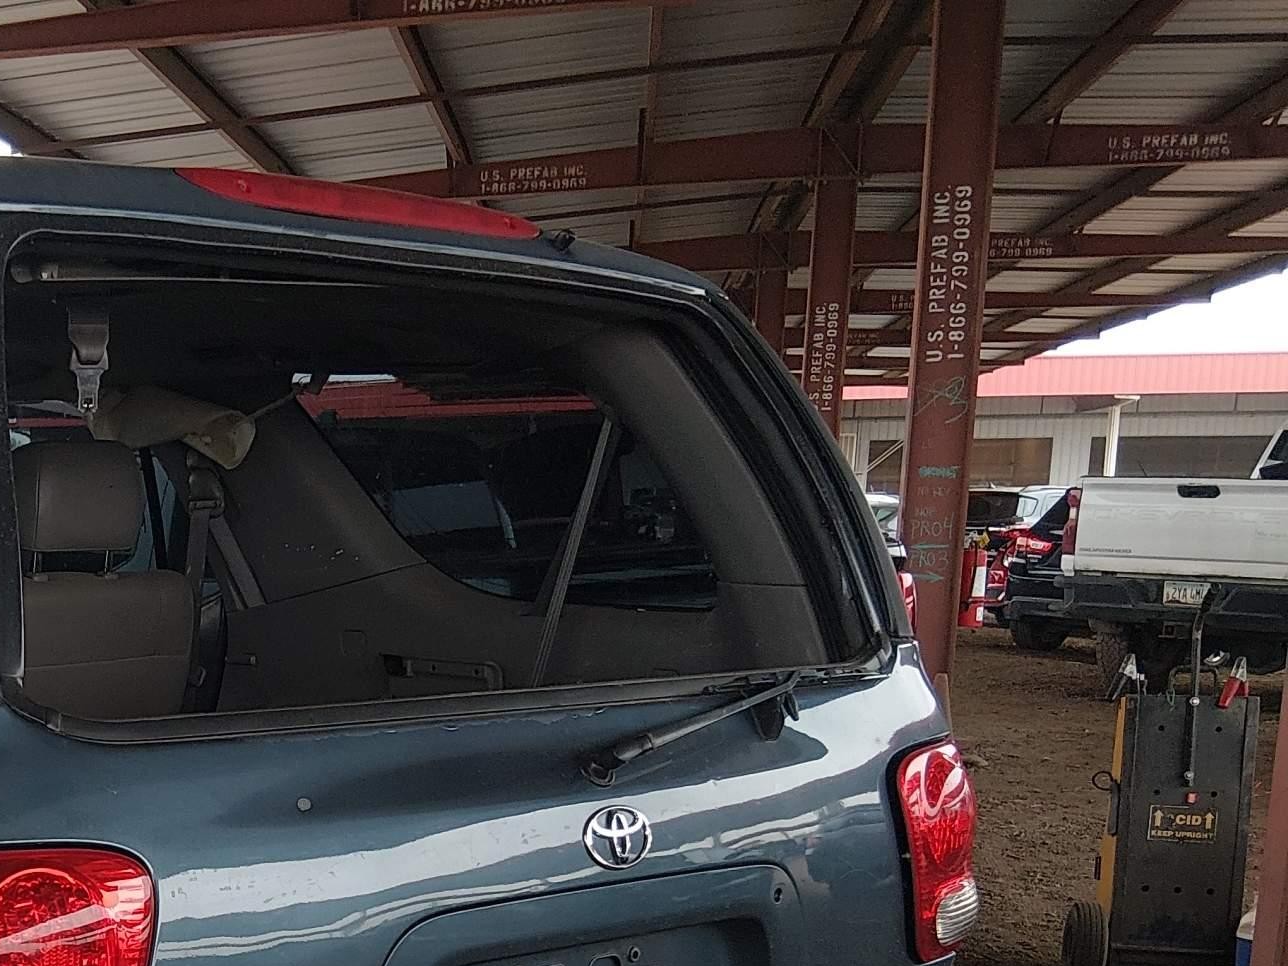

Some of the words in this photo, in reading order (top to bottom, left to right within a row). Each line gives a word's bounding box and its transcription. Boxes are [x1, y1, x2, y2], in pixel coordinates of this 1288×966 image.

[1142, 133, 1198, 147] PREFAB
[480, 170, 504, 182] U.S.
[510, 167, 558, 180] PREFAB
[563, 165, 588, 177] INC.
[481, 178, 586, 194] 1-866-799-0969
[932, 184, 952, 224] INC.
[928, 234, 949, 313] PREFAB
[947, 185, 973, 360] 1-866-799-0969
[814, 302, 827, 327] INC.
[810, 332, 824, 382] PREFAB
[821, 302, 840, 411] 1-866-799-0969
[925, 323, 945, 363] U.S.
